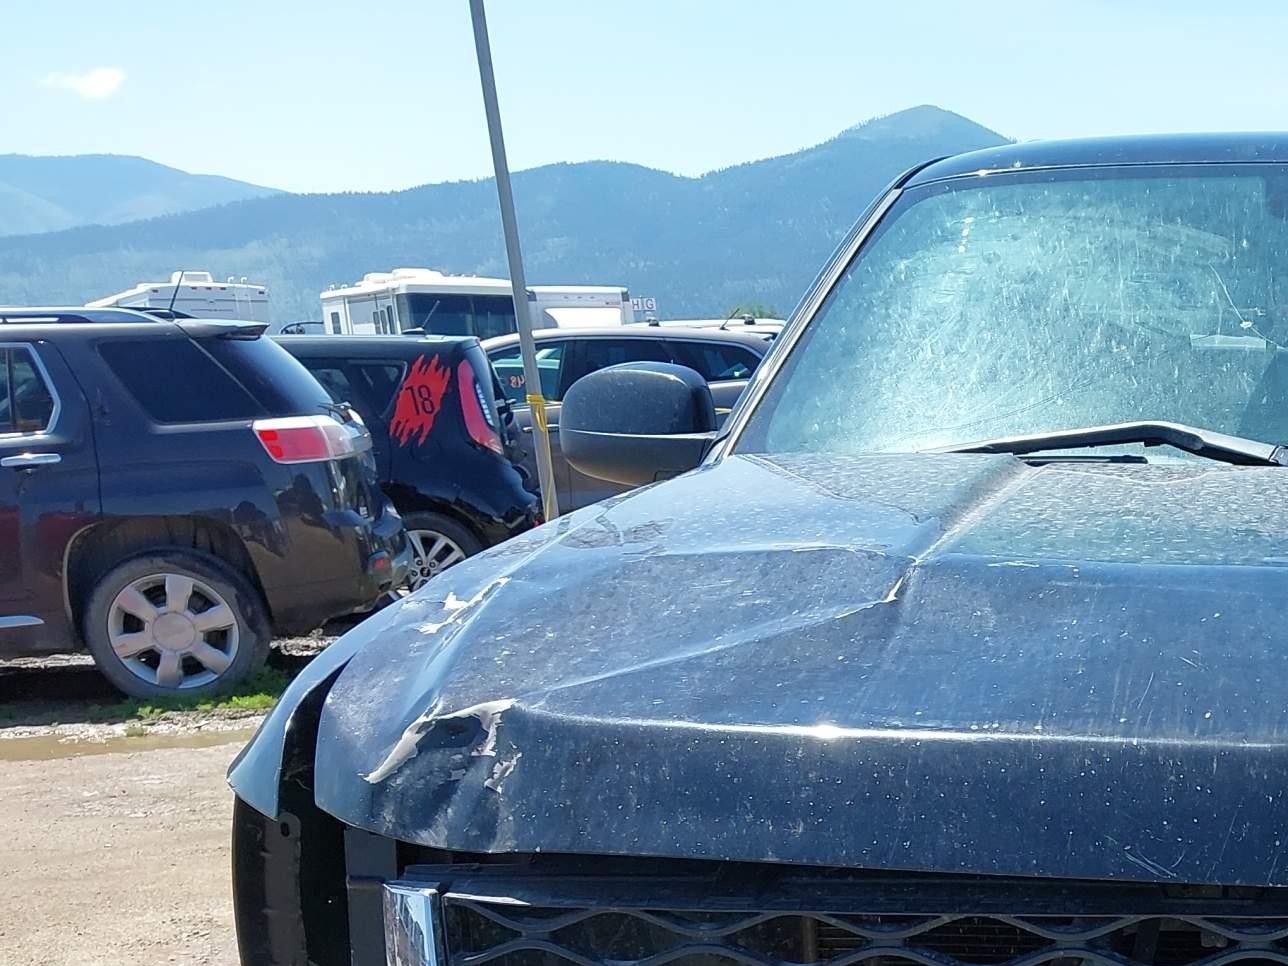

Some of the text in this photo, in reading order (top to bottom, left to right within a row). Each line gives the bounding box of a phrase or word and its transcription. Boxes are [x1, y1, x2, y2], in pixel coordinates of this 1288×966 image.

[632, 298, 640, 310] H
[645, 298, 654, 310] G
[405, 384, 435, 416] 18
